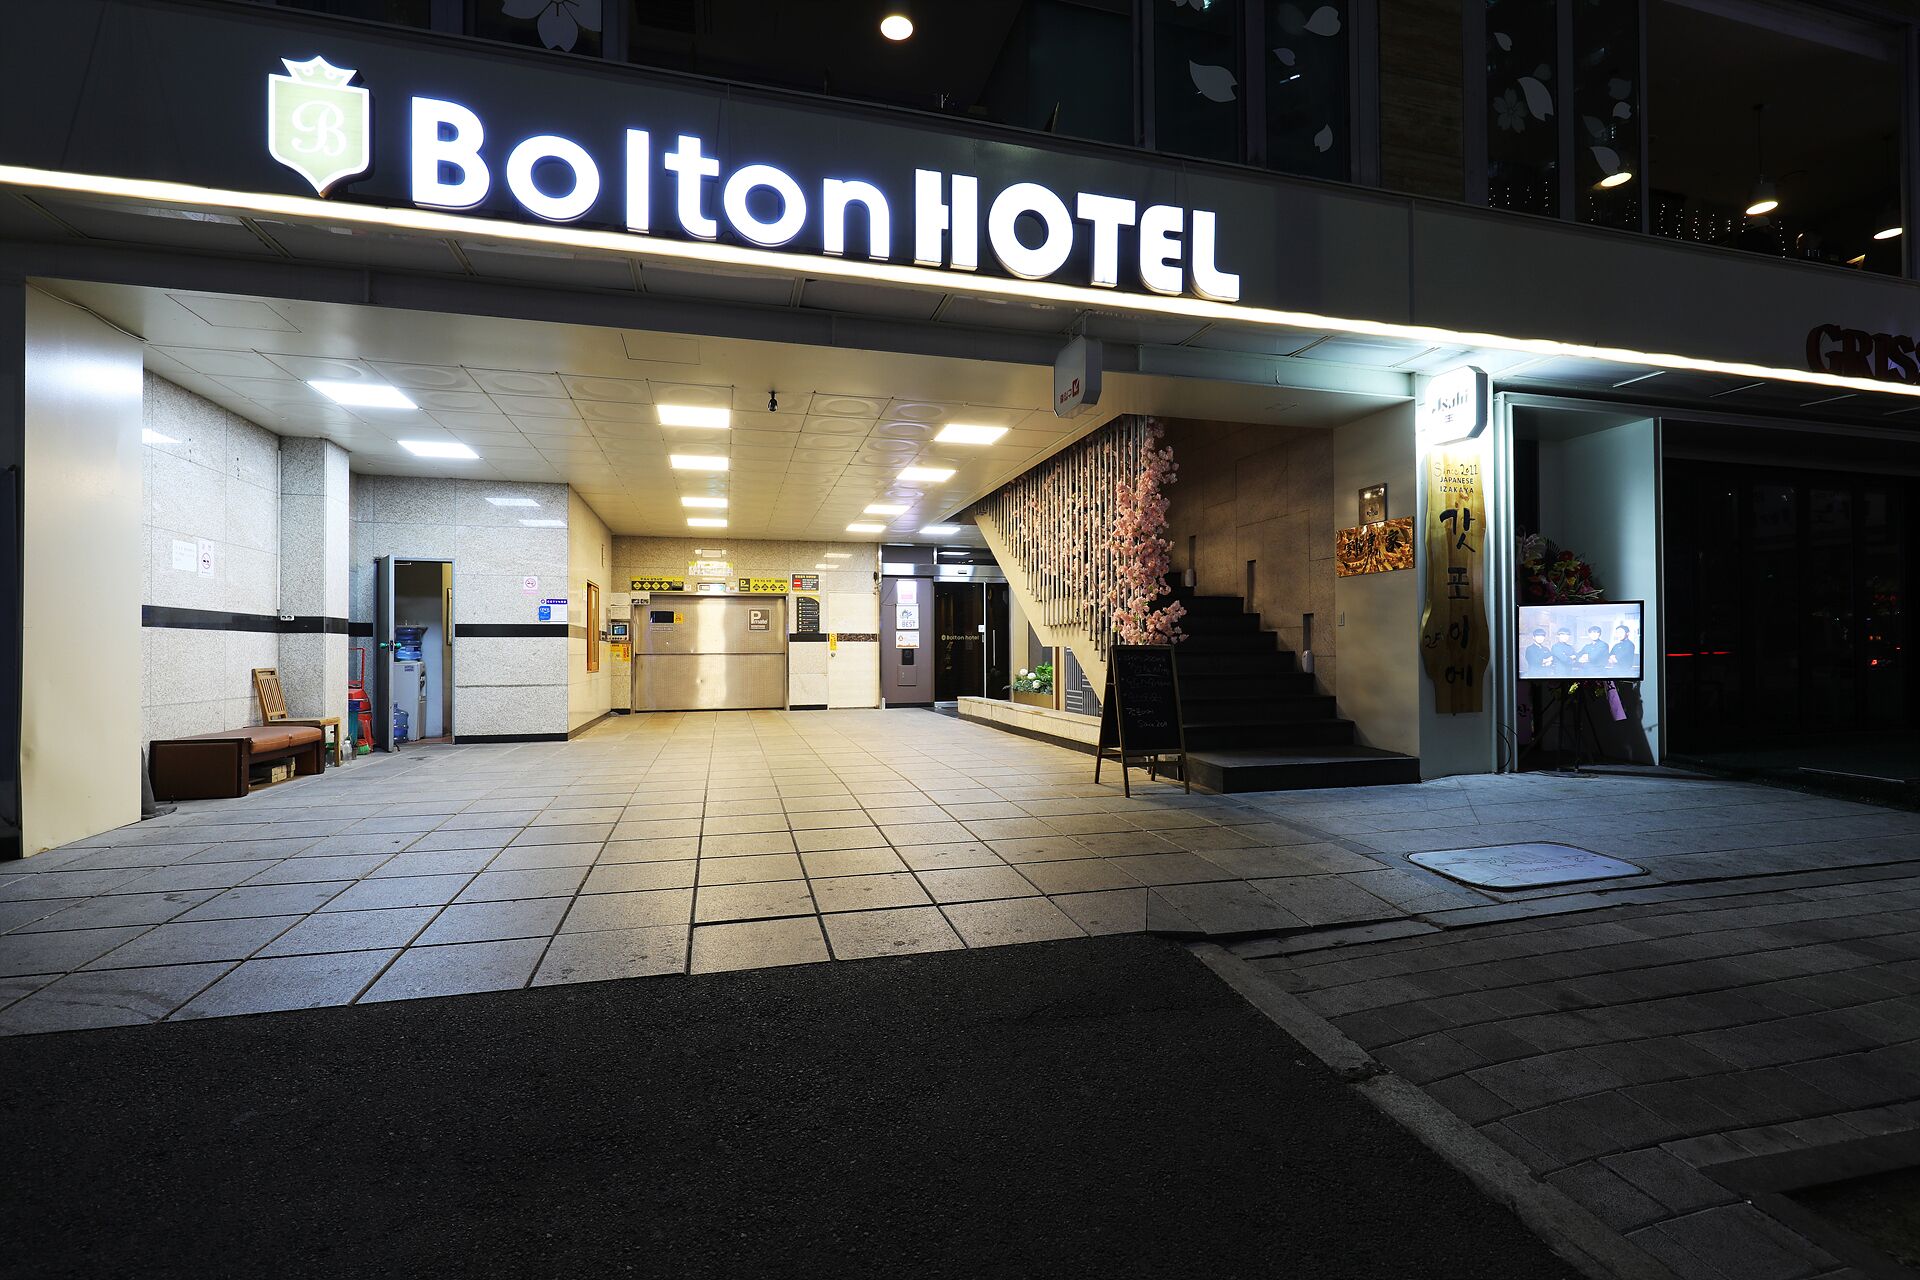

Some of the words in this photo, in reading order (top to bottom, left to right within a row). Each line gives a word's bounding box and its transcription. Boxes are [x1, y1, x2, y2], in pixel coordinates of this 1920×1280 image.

[411, 95, 890, 262] Bolton
[914, 168, 1240, 302] HOTEL
[1433, 462, 1459, 478] Since
[1460, 463, 1479, 476] 2011
[1440, 476, 1474, 485] JAPANESE
[1440, 485, 1474, 494] IZAKAYA
[1439, 507, 1477, 688] 갓포이에
[901, 620, 916, 628] BEST
